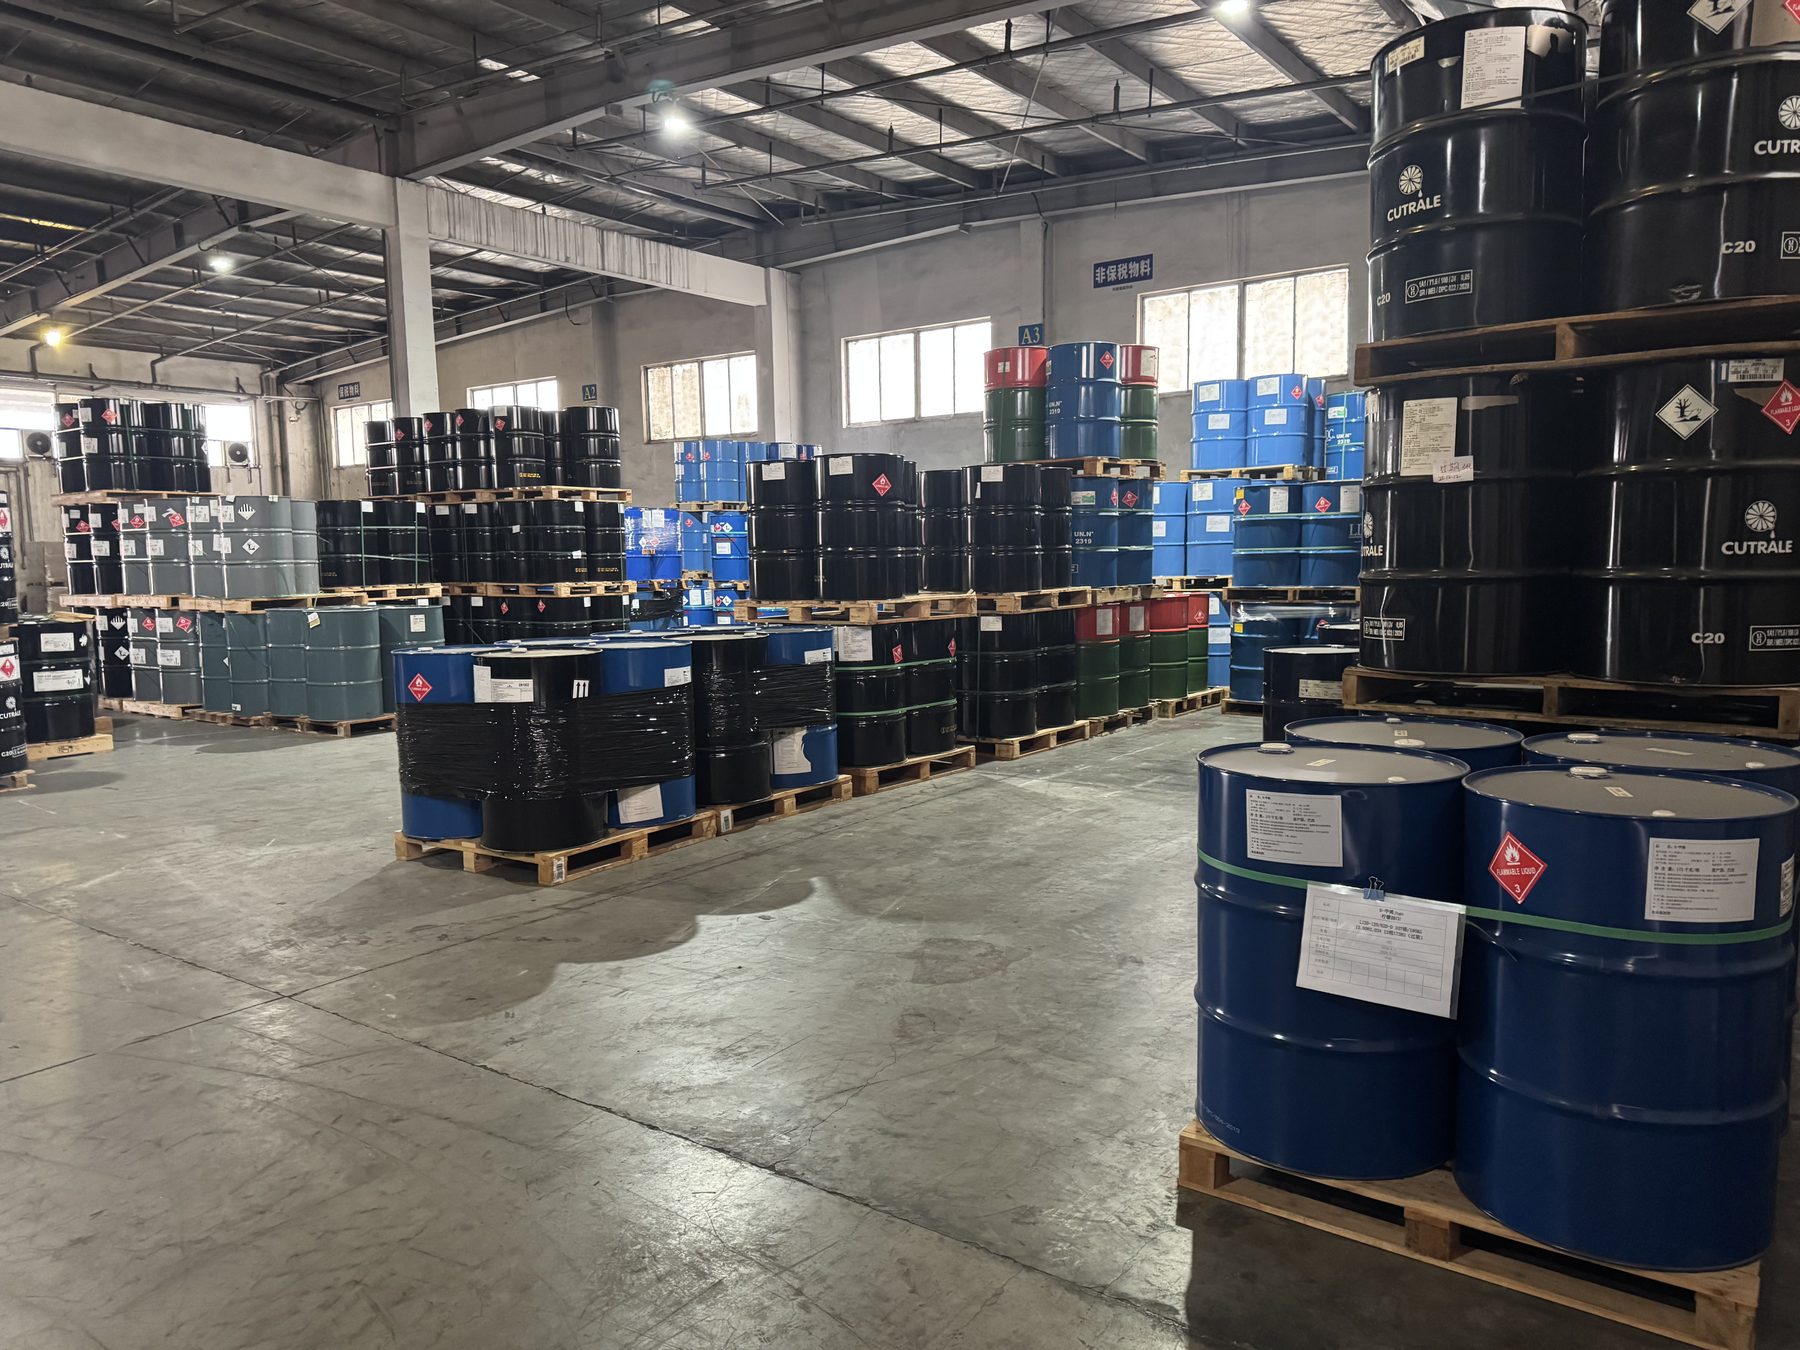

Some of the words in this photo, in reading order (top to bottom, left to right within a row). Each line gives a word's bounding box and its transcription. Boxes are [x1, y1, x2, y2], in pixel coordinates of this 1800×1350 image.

[1387, 194, 1441, 222] CUTRALE
[1721, 240, 1756, 254] C20
[1095, 258, 1151, 283] 非保税物料
[1377, 292, 1391, 306] C20
[1021, 327, 1040, 345] A3
[584, 386, 596, 400] A2
[1785, 419, 1791, 427] 3
[1721, 540, 1793, 555] CUTRALE
[1691, 632, 1725, 644] C20
[1496, 868, 1520, 876] FLAMMABLE
[1521, 867, 1536, 875] LIQUID
[1514, 884, 1520, 893] 3
